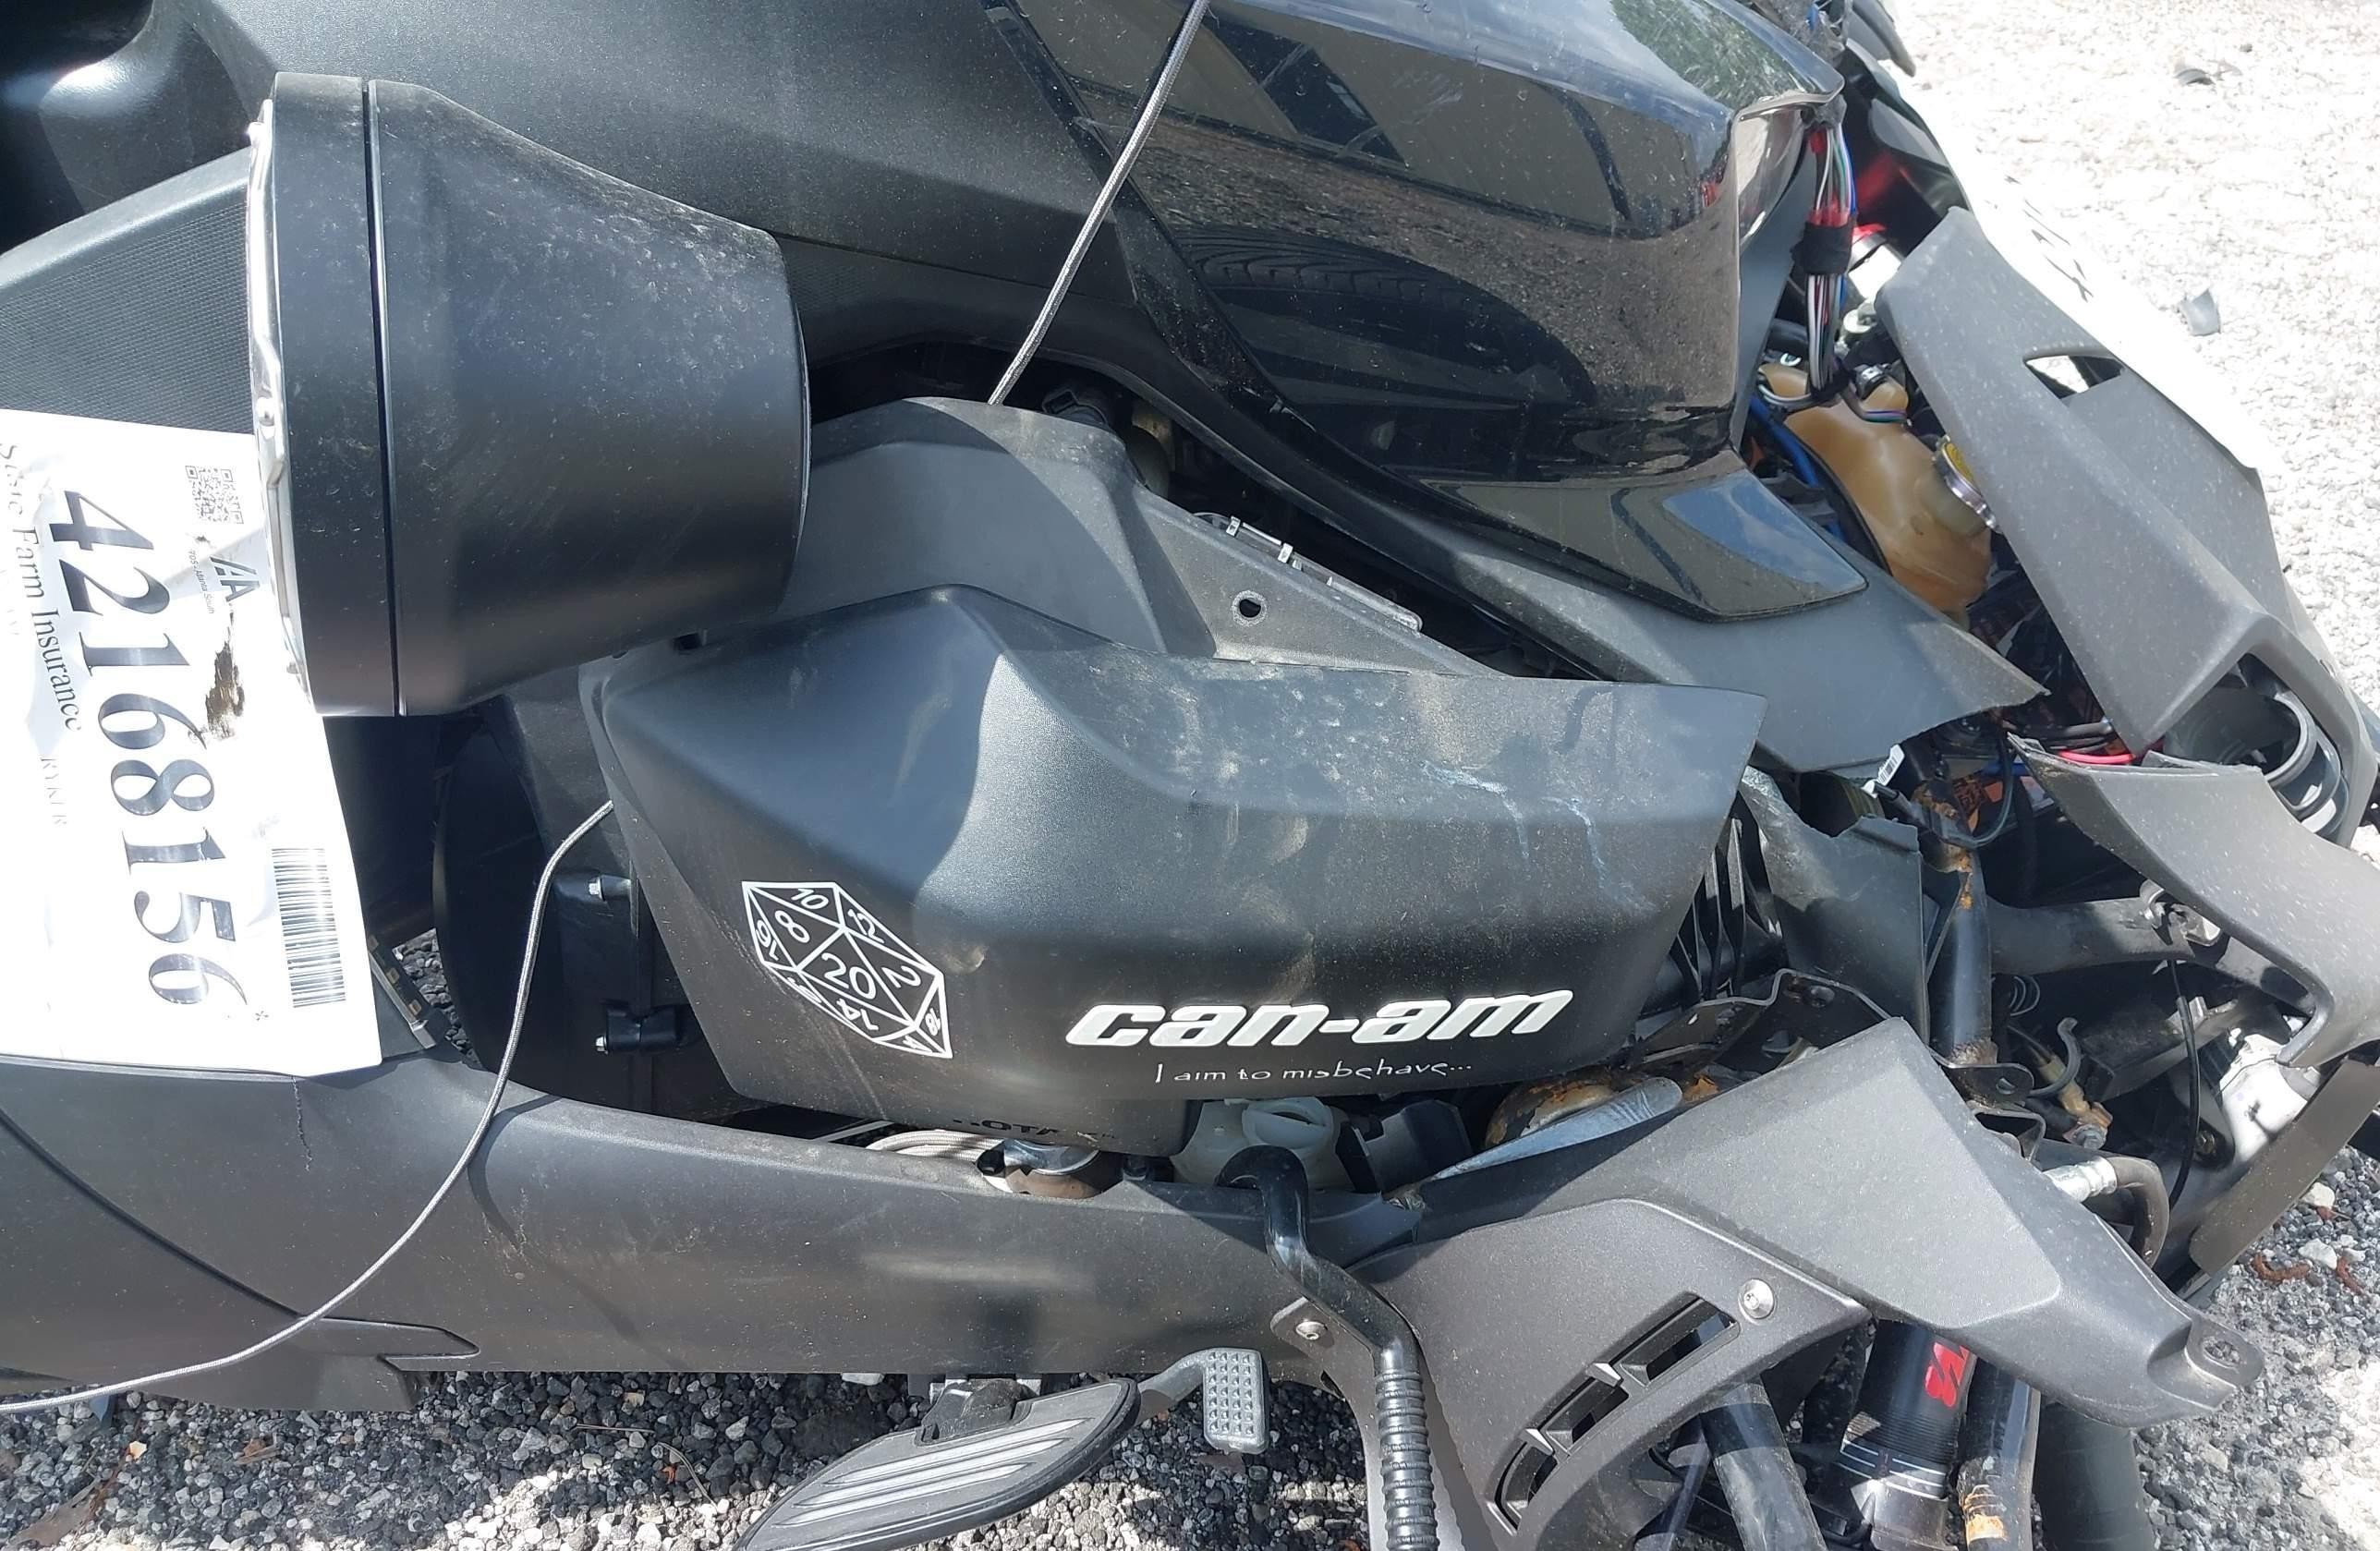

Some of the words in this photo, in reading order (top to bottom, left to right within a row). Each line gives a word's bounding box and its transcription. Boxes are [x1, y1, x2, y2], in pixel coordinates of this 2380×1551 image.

[13, 526, 44, 599] Farm
[31, 608, 81, 732] Insurance
[50, 490, 248, 1005] 42168156
[791, 888, 830, 910] 10
[774, 910, 810, 943] 8
[847, 908, 885, 944] 12
[820, 952, 877, 1000] 20
[1065, 989, 1573, 1047] can-am
[1172, 1069, 1227, 1082] aim
[1236, 1067, 1271, 1081] to
